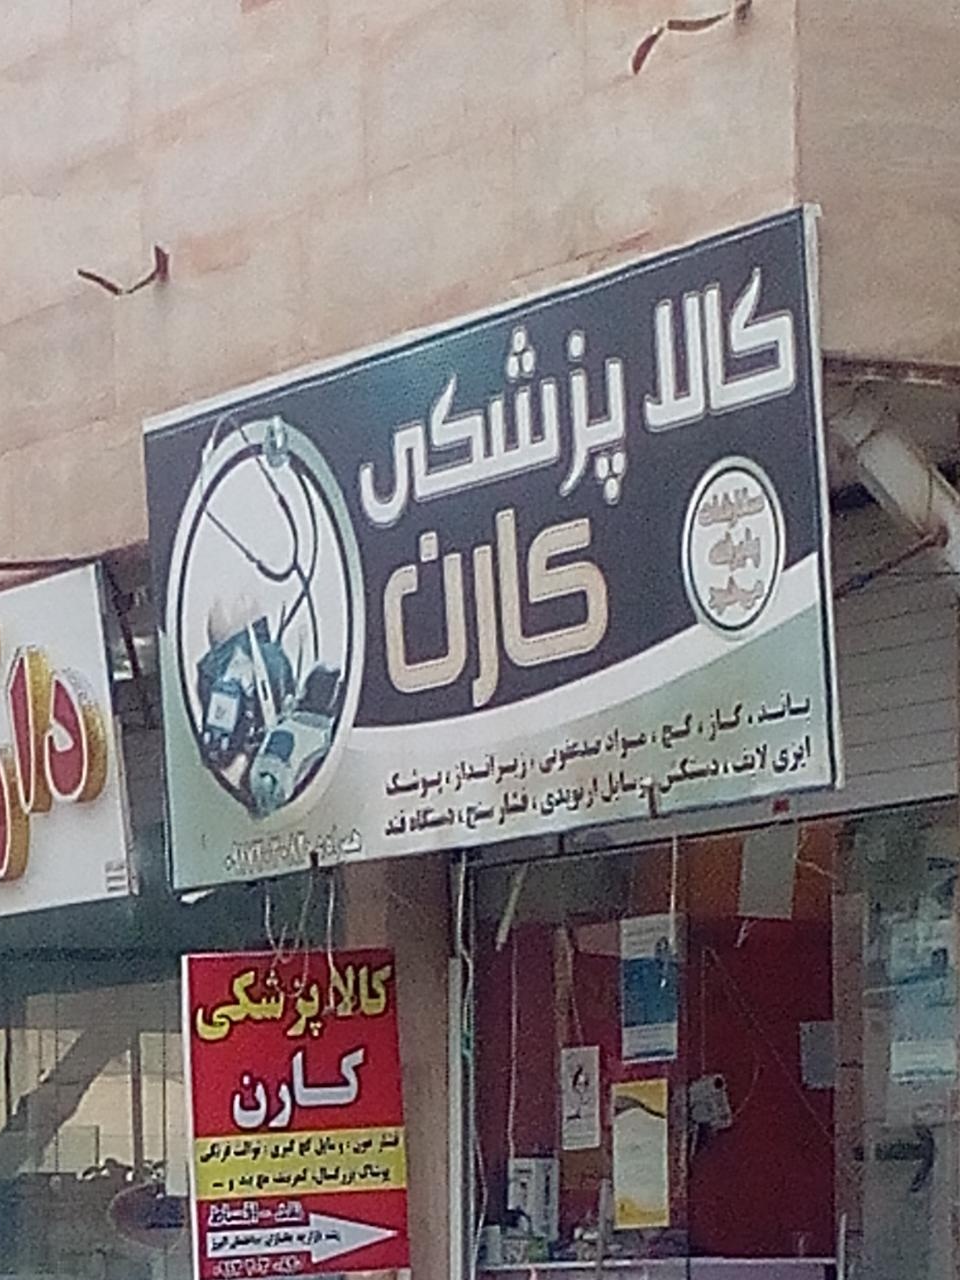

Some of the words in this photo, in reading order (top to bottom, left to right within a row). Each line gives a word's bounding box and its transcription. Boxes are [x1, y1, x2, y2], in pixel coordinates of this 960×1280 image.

[643, 267, 797, 432] کالا
[359, 328, 626, 526] پزشکی
[383, 508, 609, 706] کارن
[196, 970, 323, 1041] پزشکی
[329, 965, 391, 1016] کالا
[233, 1048, 365, 1128] کارن
